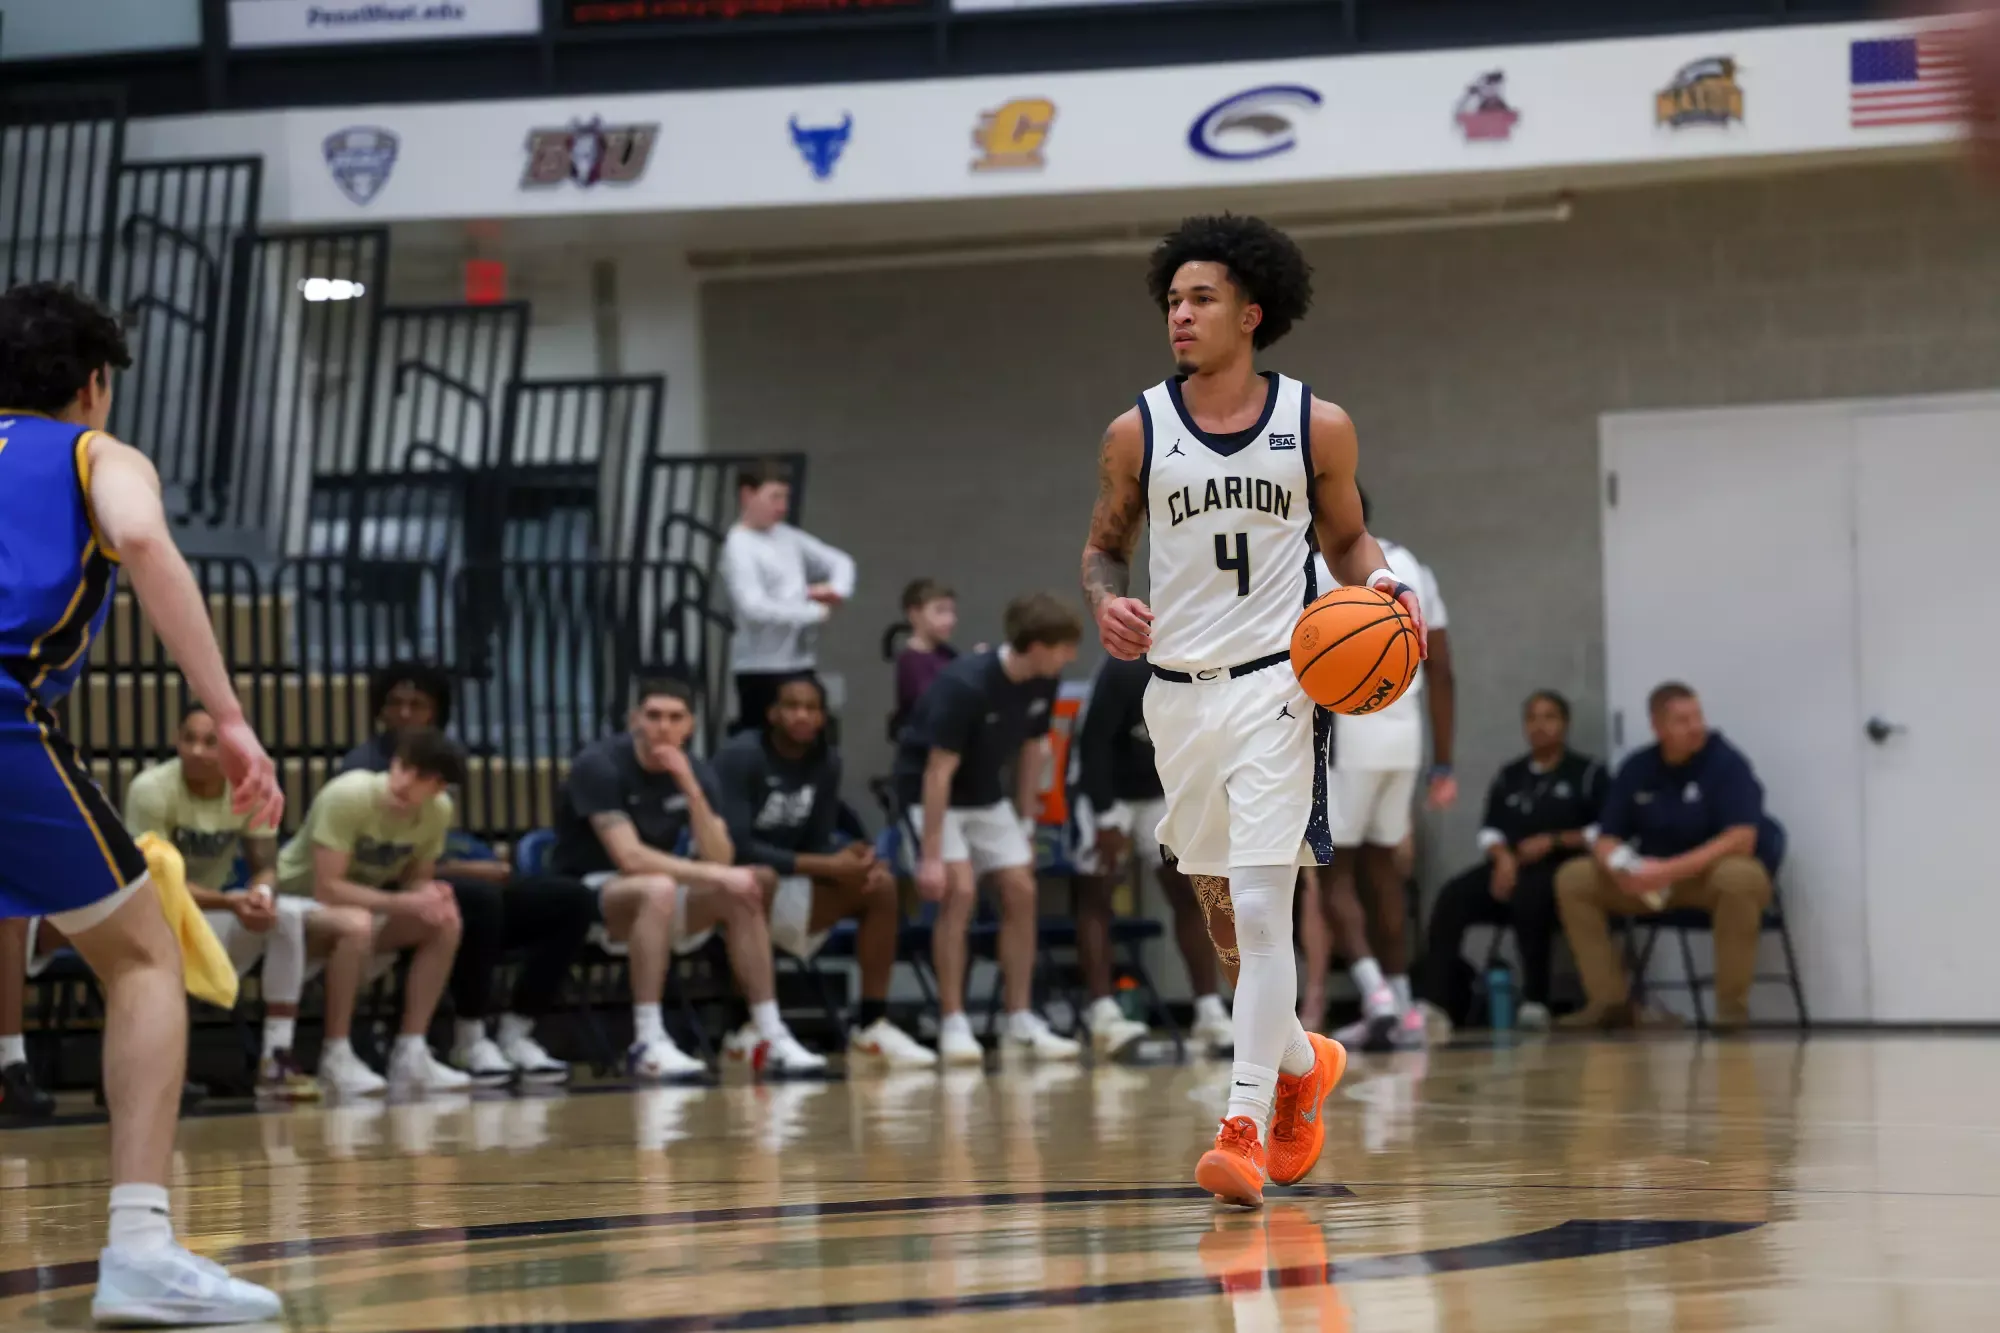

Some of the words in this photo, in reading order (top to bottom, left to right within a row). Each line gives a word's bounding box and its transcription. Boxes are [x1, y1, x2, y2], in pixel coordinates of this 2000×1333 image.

[1269, 437, 1296, 446] PSAC
[1168, 476, 1292, 526] CLARION
[1214, 532, 1250, 597] 4
